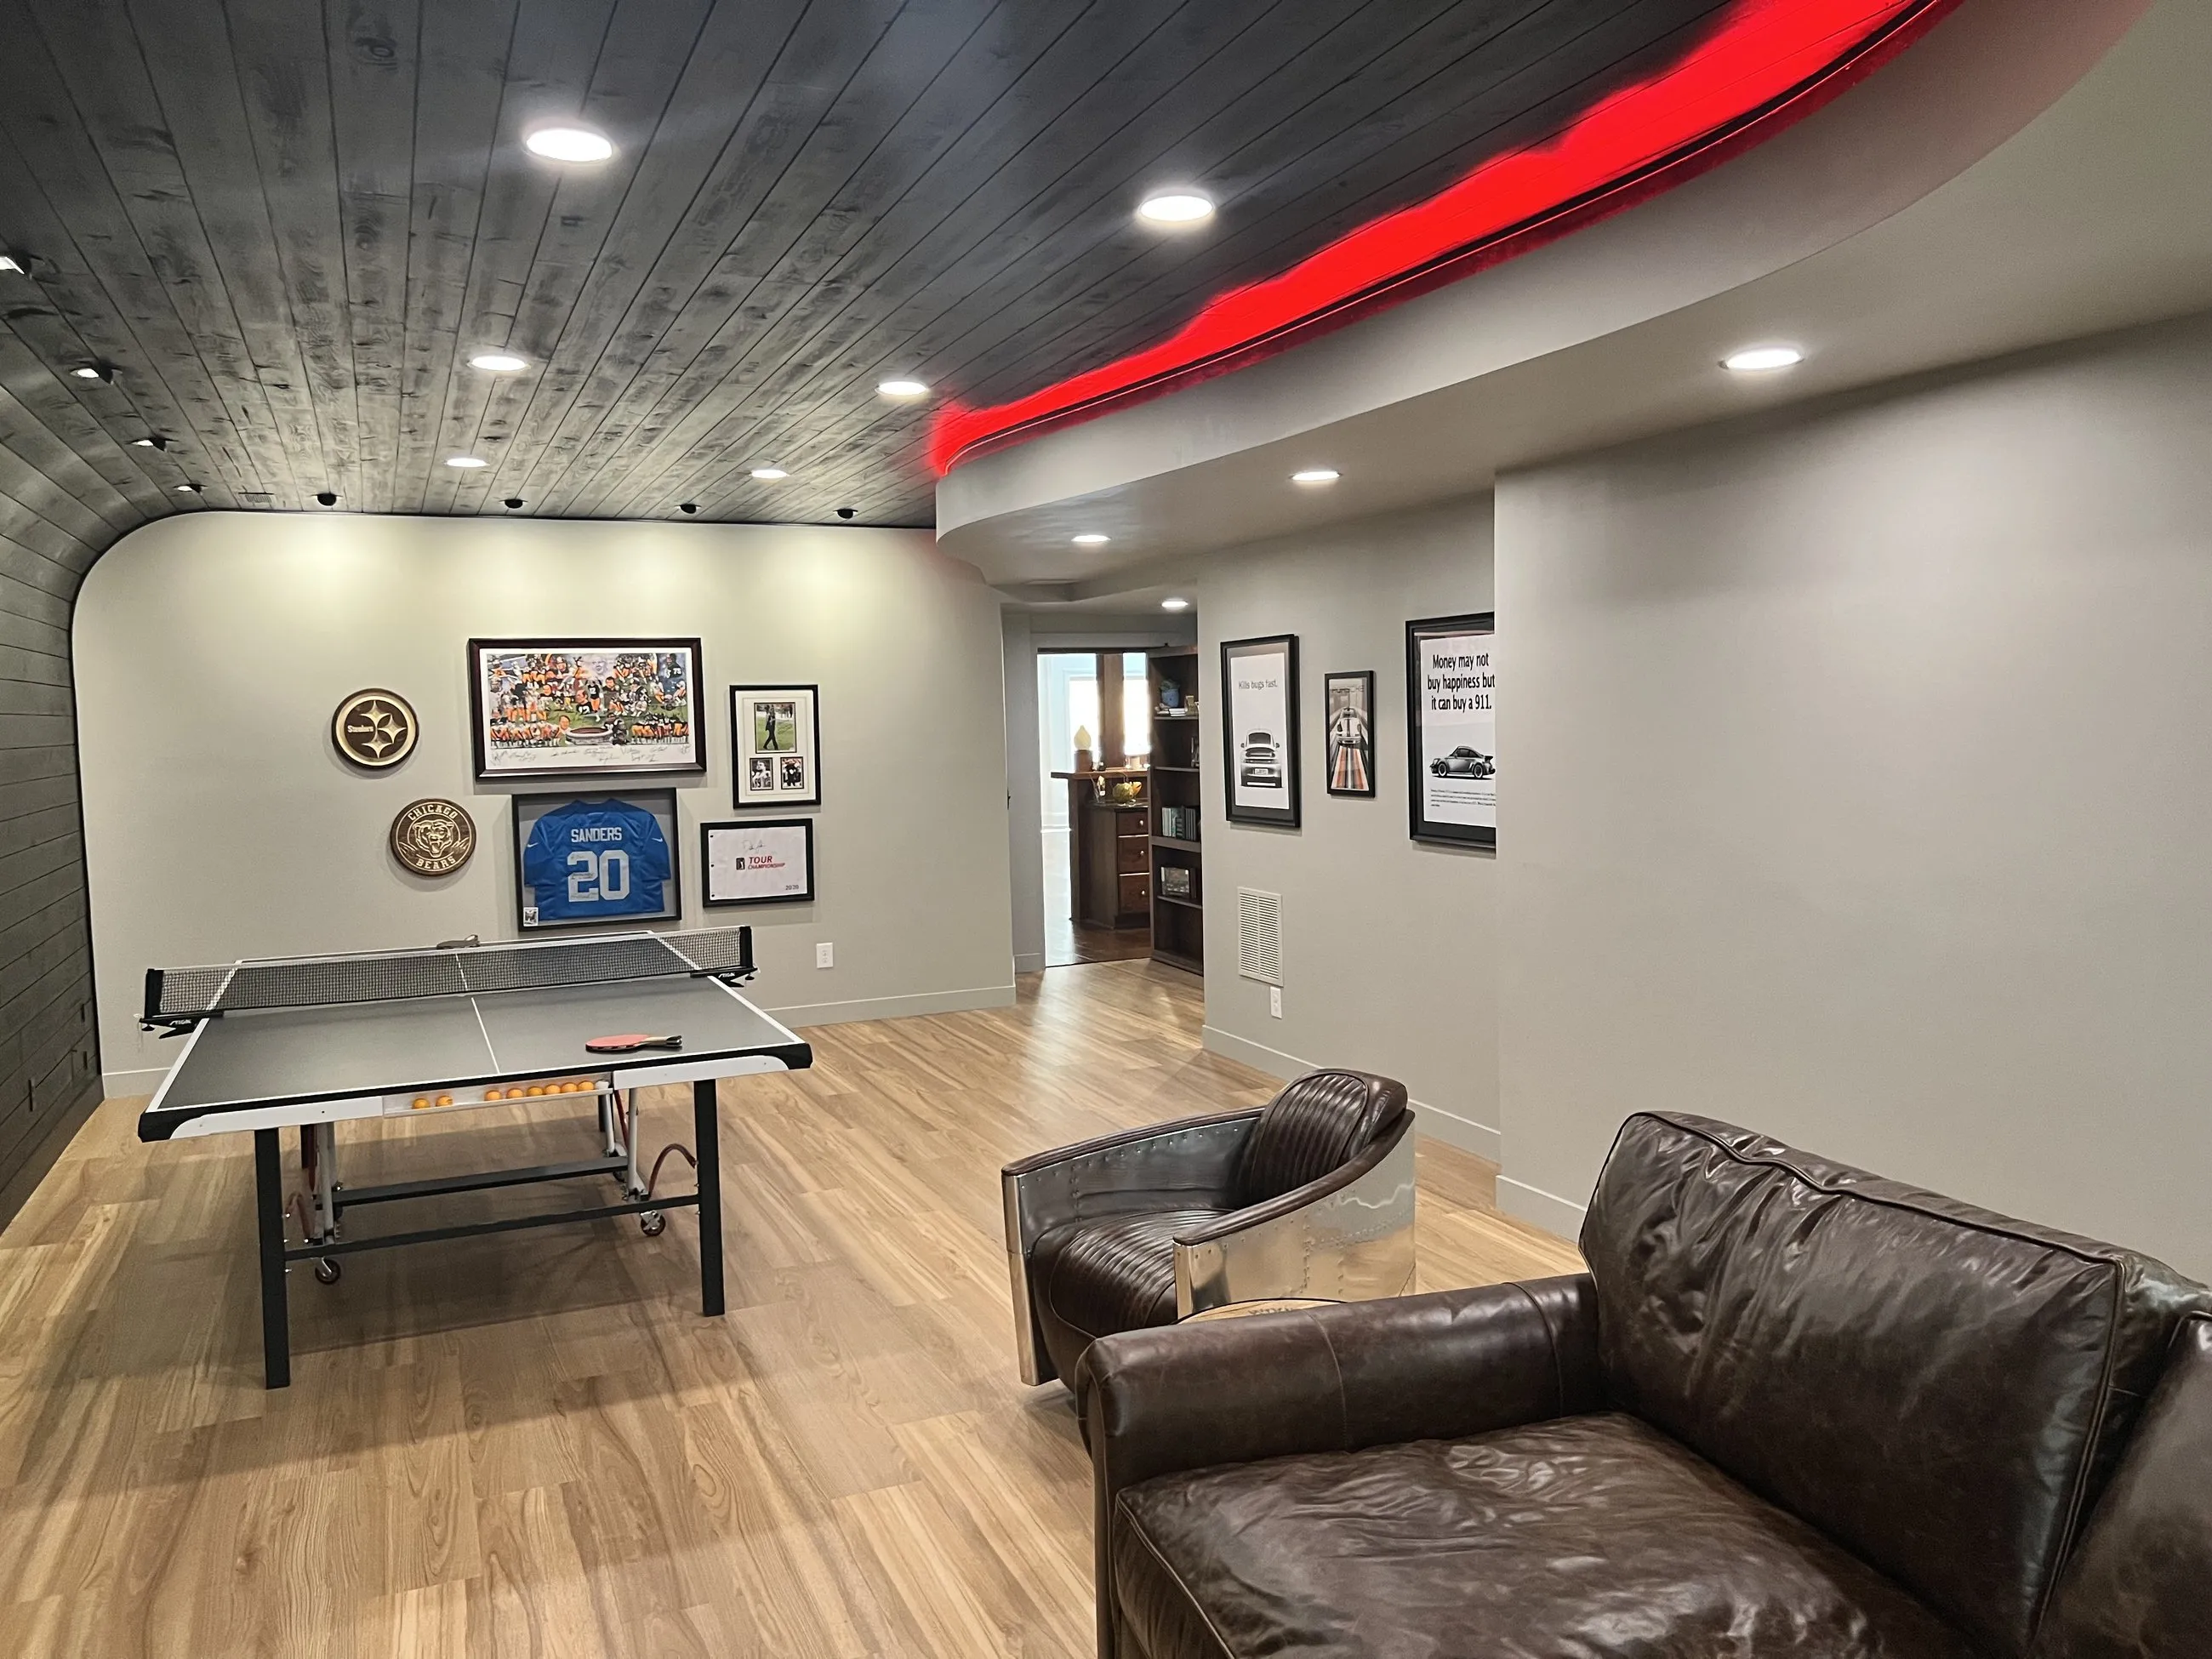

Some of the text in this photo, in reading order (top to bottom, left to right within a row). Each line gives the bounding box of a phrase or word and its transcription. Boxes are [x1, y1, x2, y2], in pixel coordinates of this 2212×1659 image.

[1433, 653, 1489, 671] Money may not
[1251, 681, 1264, 690] bugs
[1428, 672, 1495, 693] buy happiness but
[1431, 694, 1491, 713] it can buy a 911.
[408, 804, 458, 821] CHICAGO
[571, 827, 622, 842] SANDERS
[416, 855, 456, 869] BEARS
[567, 850, 630, 902] 20
